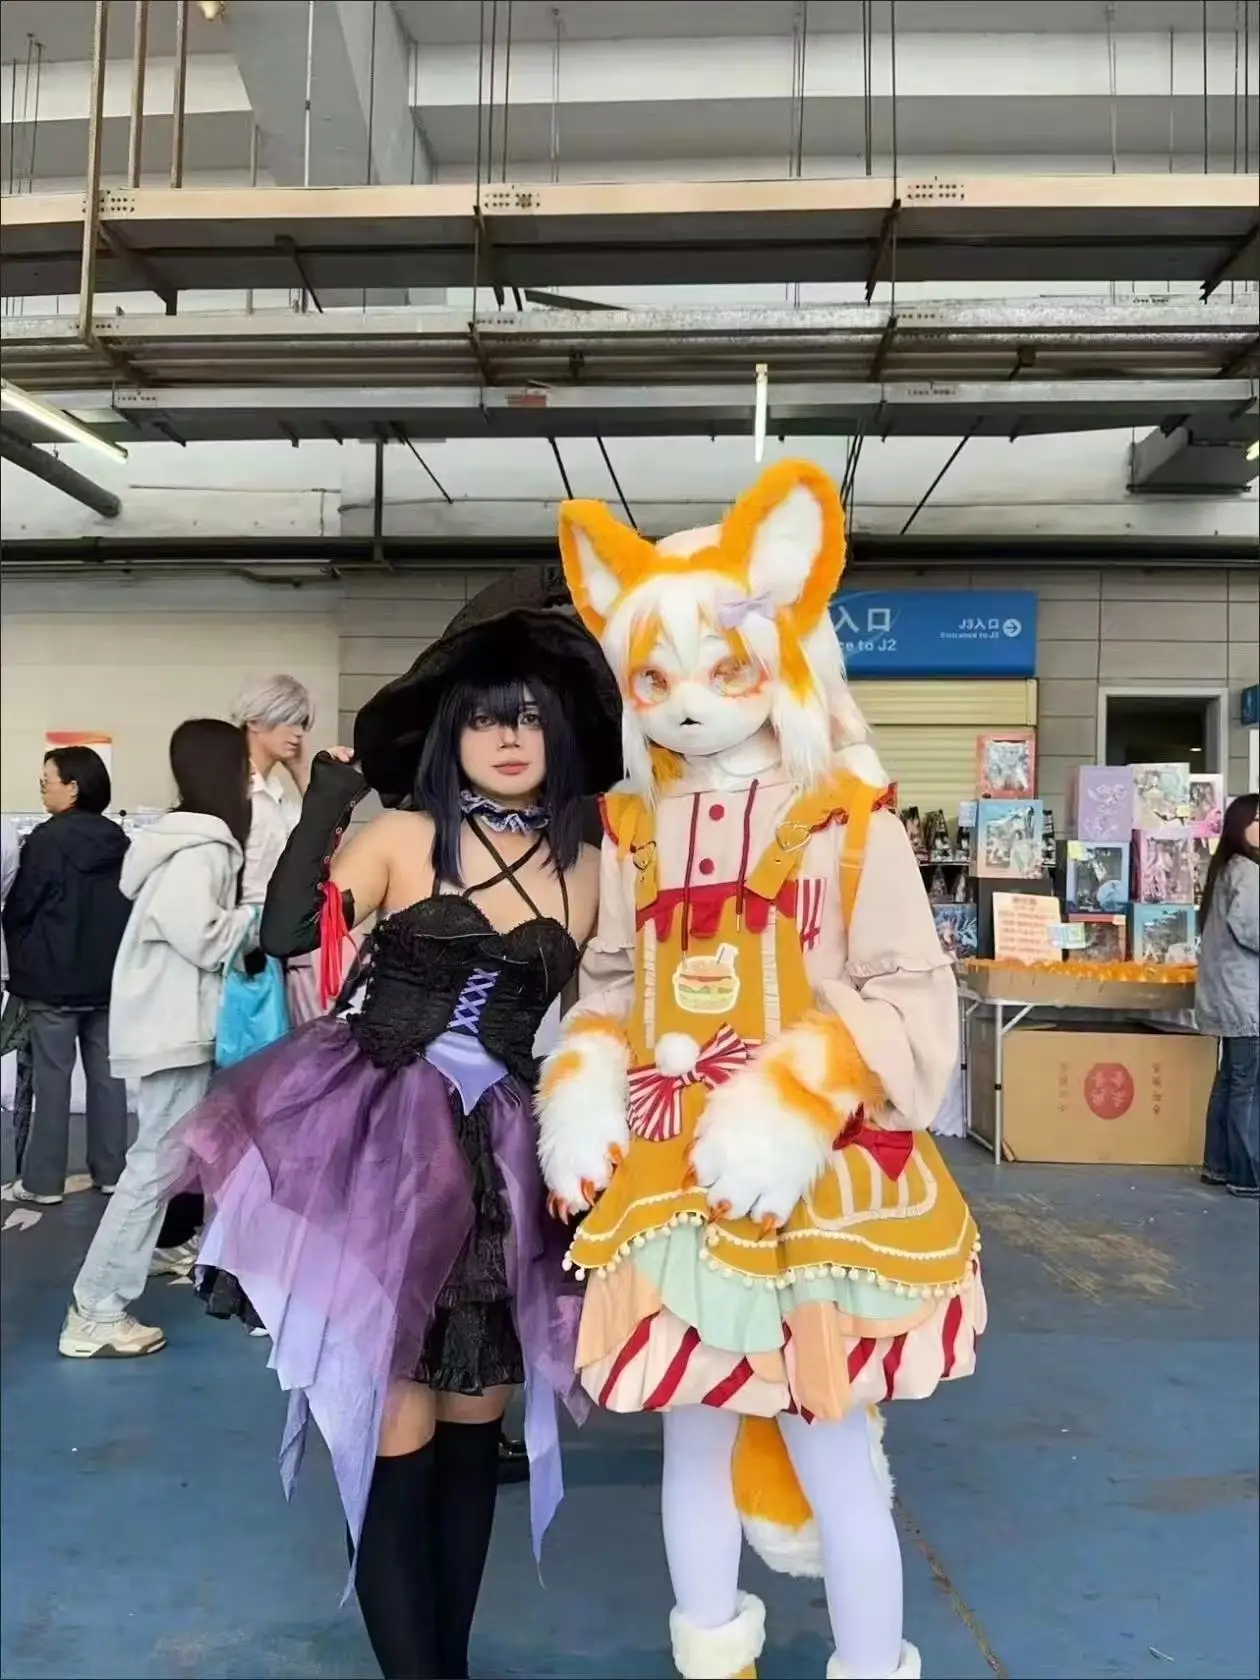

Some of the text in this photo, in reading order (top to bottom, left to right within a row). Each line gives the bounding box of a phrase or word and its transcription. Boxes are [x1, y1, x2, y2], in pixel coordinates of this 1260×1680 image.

[834, 605, 891, 633] 入口
[858, 639, 873, 651] to
[878, 638, 897, 651] J2
